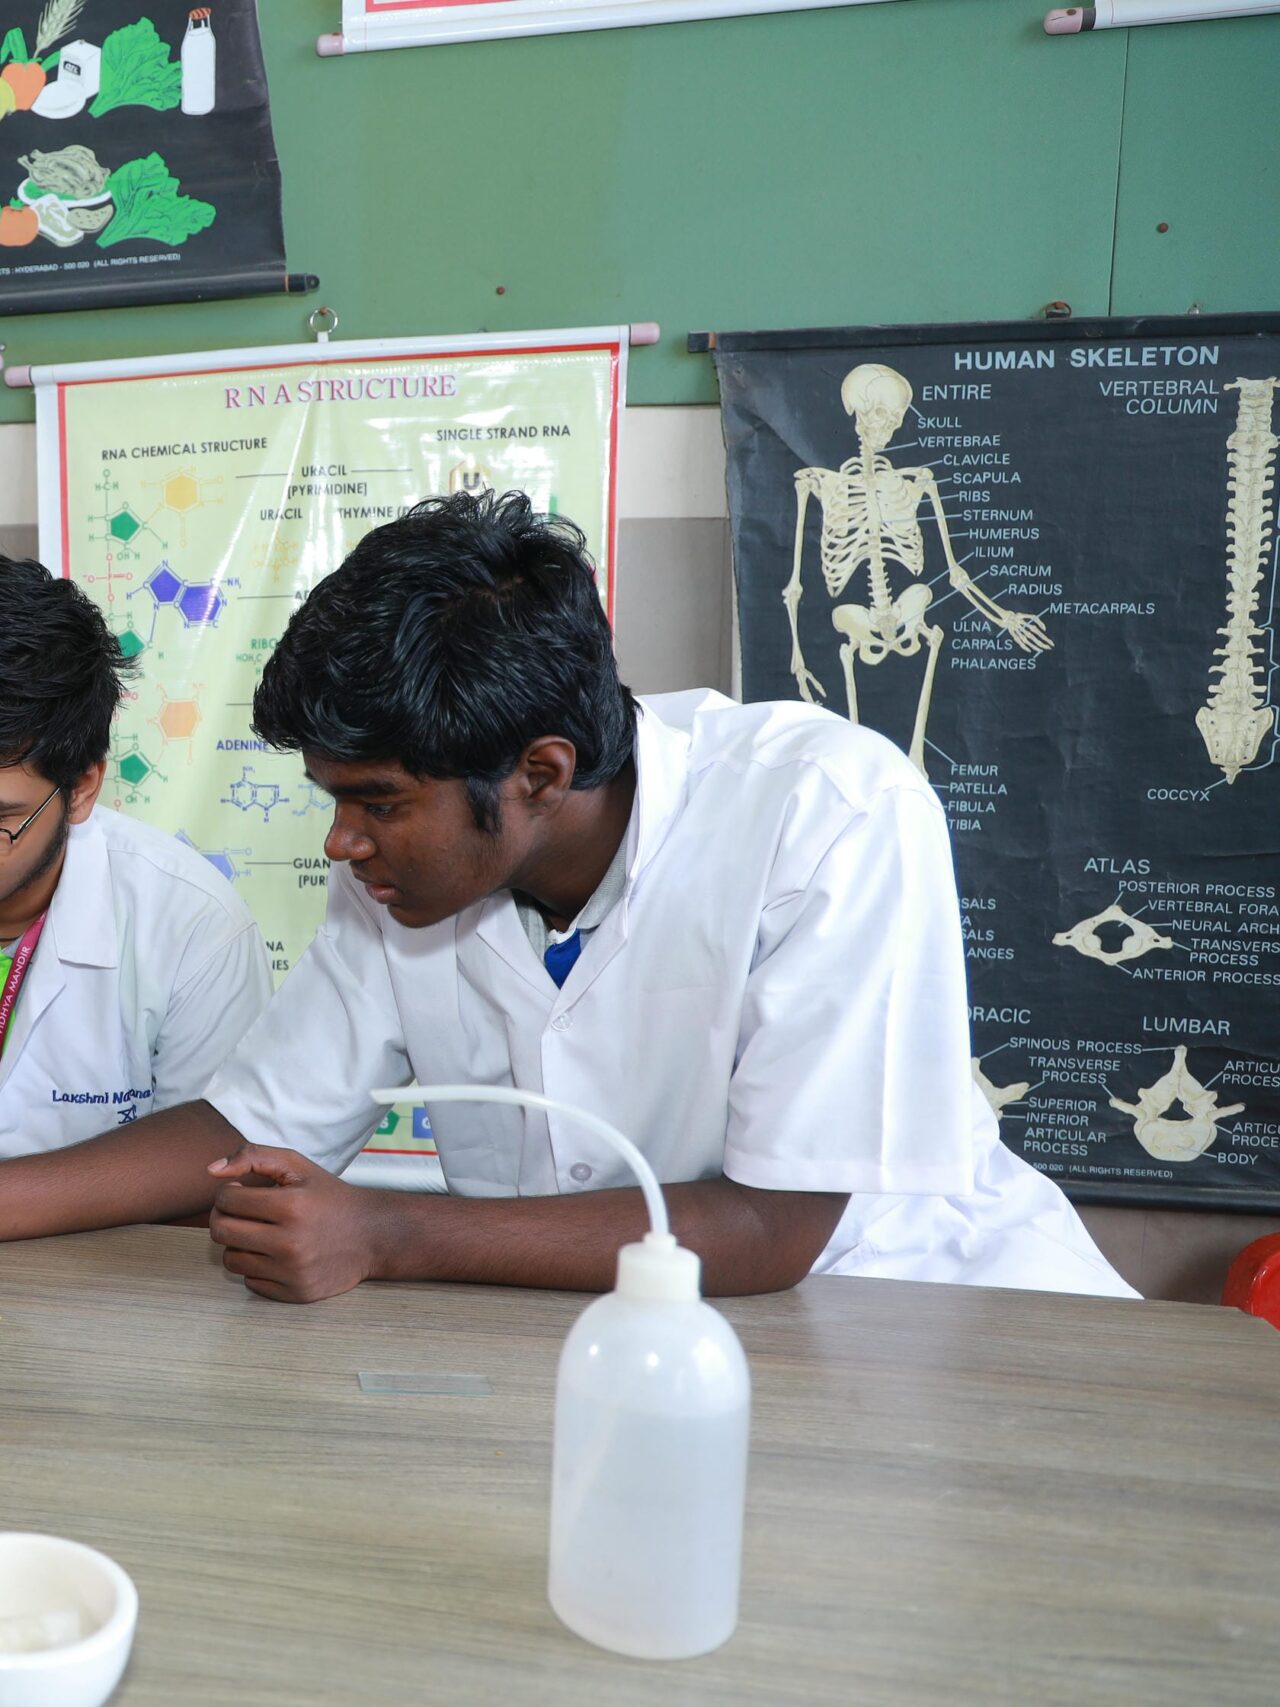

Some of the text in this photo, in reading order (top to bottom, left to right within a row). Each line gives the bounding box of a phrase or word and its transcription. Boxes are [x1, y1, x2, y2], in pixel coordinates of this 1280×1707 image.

[955, 346, 1219, 370] HUMAN SKELETON
[297, 375, 456, 402] STRUCTURE
[922, 384, 992, 400] ENTIRE
[1100, 380, 1219, 396] VERTEBRAL
[1126, 399, 1218, 415] COLUMN
[918, 416, 962, 429] SKULL
[437, 424, 570, 442] SINGLE STRAND RNA
[918, 435, 1000, 447] VERTEBRAE
[102, 438, 267, 460] RNA CHEMICAL STRUCTURE
[943, 453, 1010, 465] CLAVICLE
[302, 465, 347, 477] URACIL
[953, 472, 1021, 484] SCAPULA
[959, 491, 990, 502] RIBS
[963, 509, 1033, 521] STERNUM
[969, 528, 1039, 540] HUMERUS
[975, 546, 1014, 558] ILIUM
[990, 565, 1051, 577] SACRUM
[1008, 584, 1062, 596] RADIUS
[1050, 602, 1155, 615] METACARPALS
[953, 621, 991, 633] ULNA
[952, 638, 1013, 650] CARPALS
[952, 658, 1036, 670] PHALANGES
[951, 765, 998, 776] FEMUR
[950, 782, 1007, 795] PATELLA
[1147, 789, 1210, 801] COCCYX
[948, 801, 996, 813] FIBULA
[948, 819, 981, 831] TIBIA
[1084, 858, 1150, 874] ATLAS
[1118, 880, 1275, 898] POSTERIOR PROCESS
[1148, 900, 1233, 914] VERTEBRAL
[1172, 920, 1280, 934] NEURAL ARCH
[1190, 952, 1259, 966] PROCESS
[9, 946, 31, 992] MANDIR
[1133, 968, 1206, 981] ANTERIOR
[1143, 1016, 1230, 1035] LUMBAR
[1010, 1037, 1142, 1054] SPINOUS PROCESS
[1028, 1057, 1120, 1071] TRANSVERSE
[1043, 1071, 1107, 1084] PROCESS
[52, 1089, 108, 1104] Lakshmi
[1028, 1098, 1096, 1112] SUPERIOR
[1026, 1113, 1088, 1126] INFERIOR
[1025, 1128, 1106, 1143] ARTICULAR
[1024, 1142, 1088, 1156] PROCESS
[1218, 1152, 1258, 1165] BODY
[1070, 1165, 1173, 1178] (ALL RIGHTS RESERVED)
